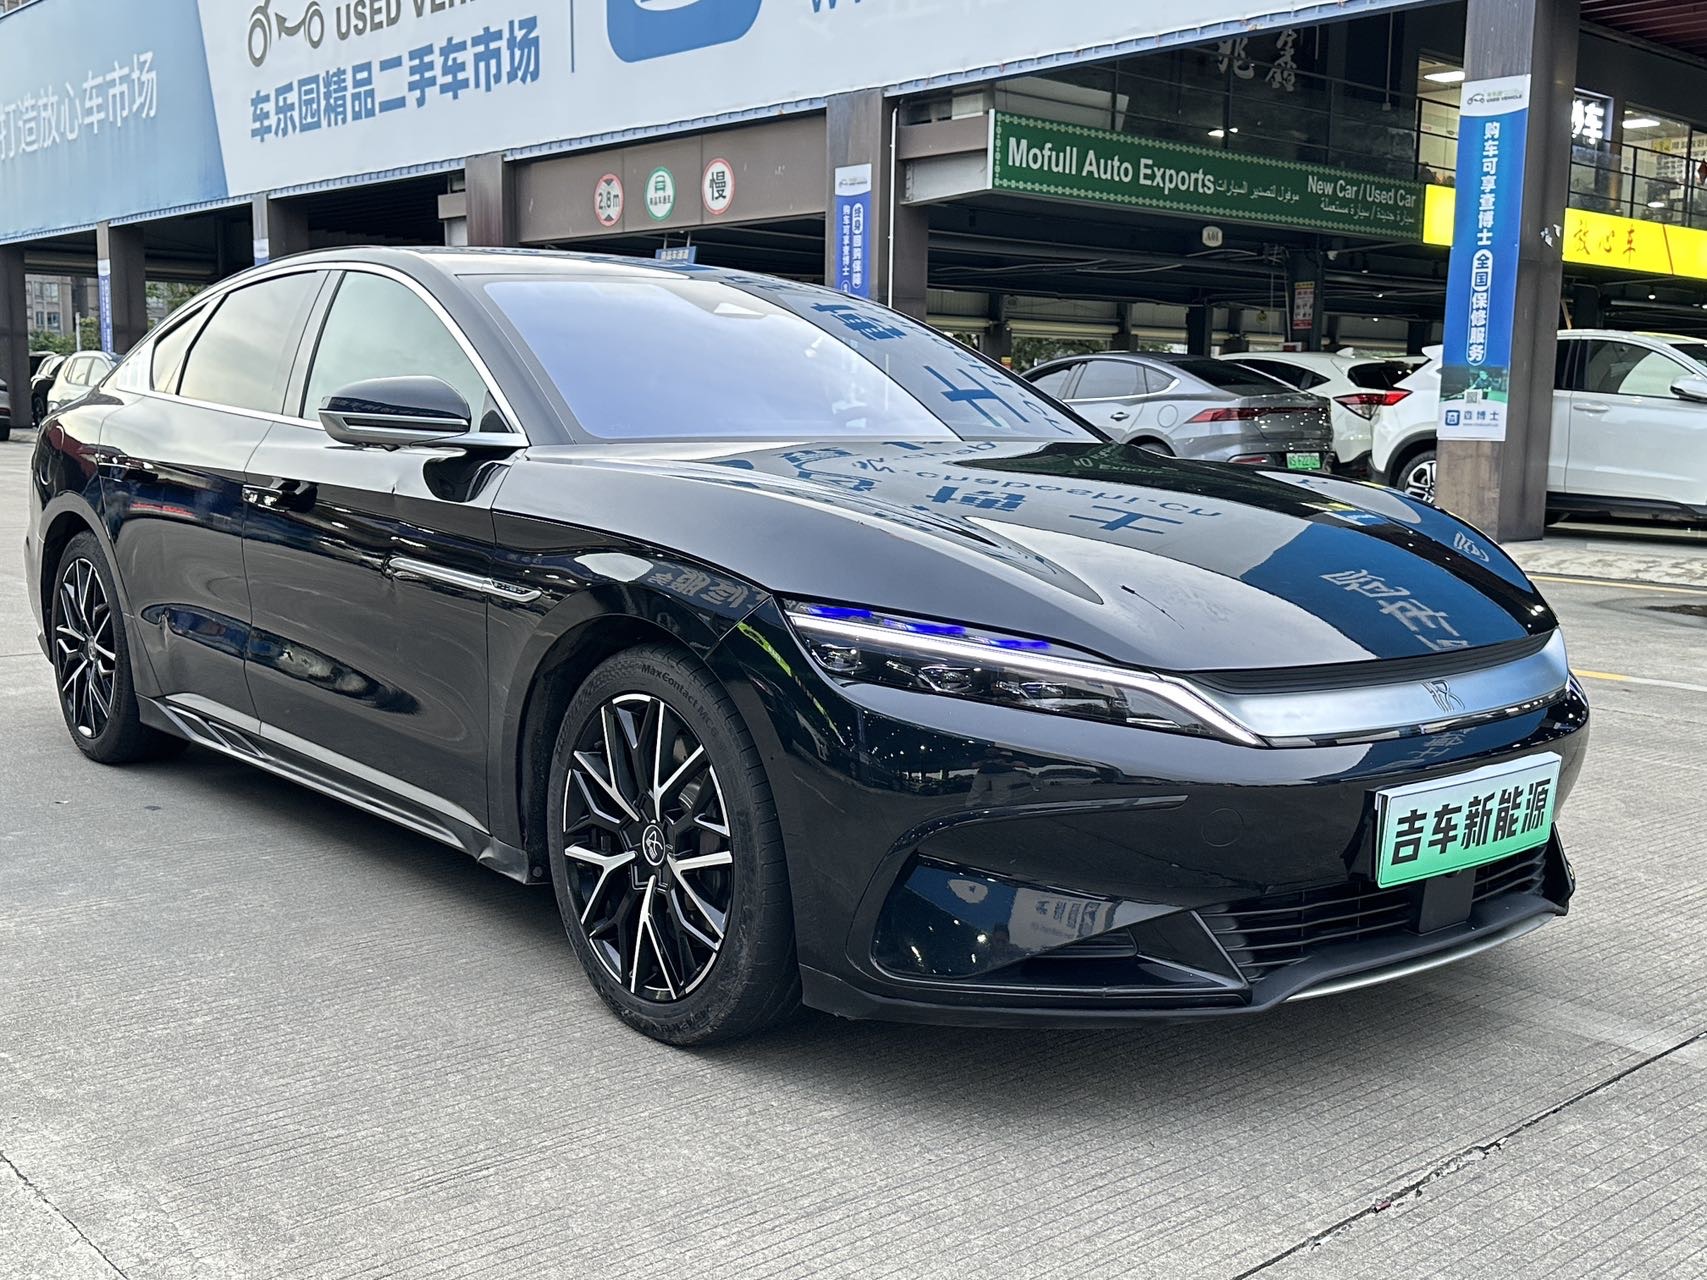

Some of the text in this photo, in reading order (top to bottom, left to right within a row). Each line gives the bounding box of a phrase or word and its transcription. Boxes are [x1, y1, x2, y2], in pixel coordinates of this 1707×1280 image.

[336, 0, 401, 41] USED
[250, 15, 540, 143] 车乐园精品二手车市场
[709, 171, 727, 201] 慢
[1007, 137, 1215, 194] Mofull Auto Exports
[1308, 175, 1416, 208] New Car / Used Car
[641, 664, 698, 707] MaxContact
[1391, 778, 1551, 866] 吉车新能源
